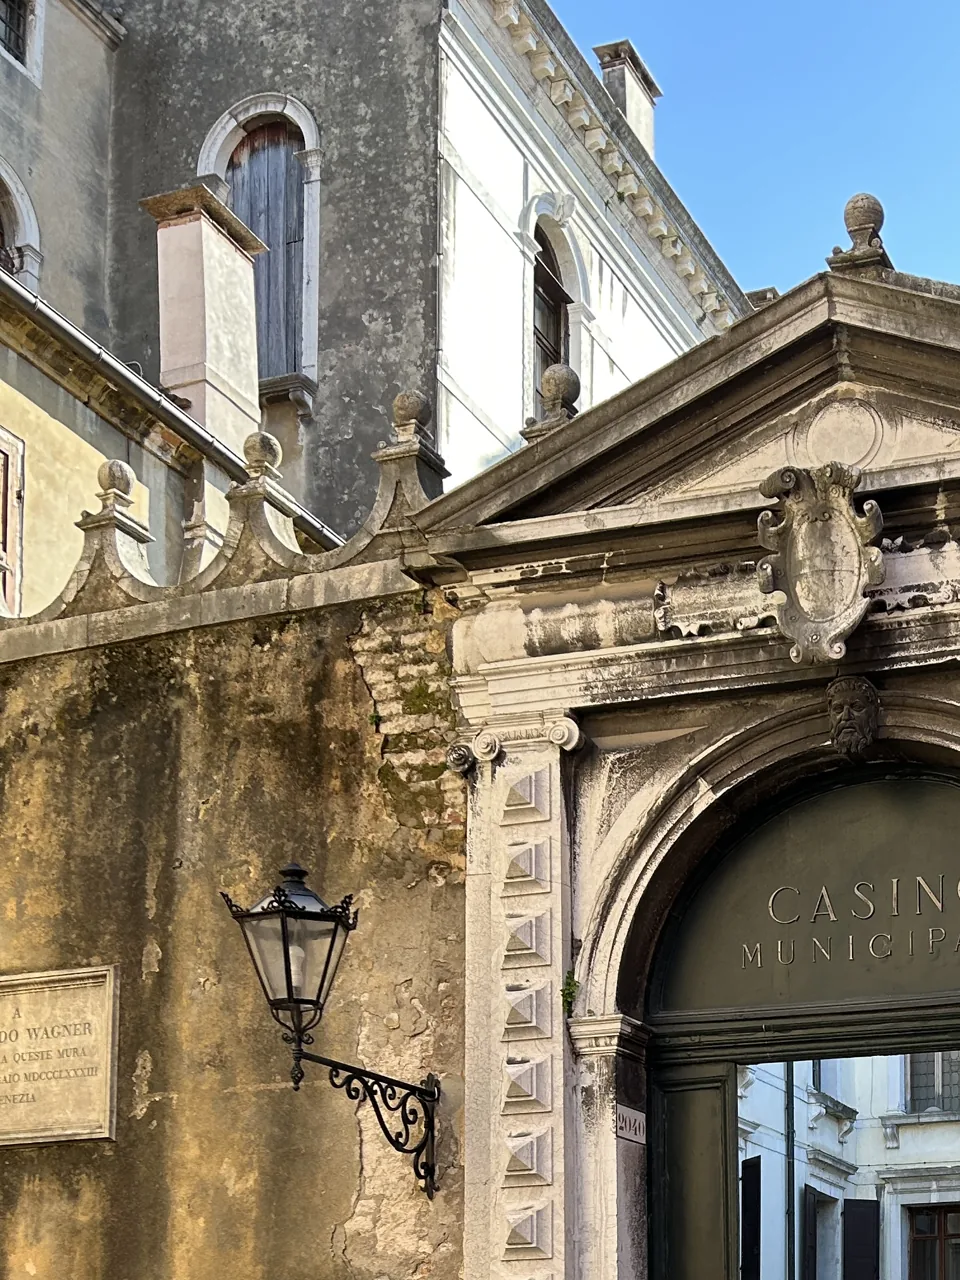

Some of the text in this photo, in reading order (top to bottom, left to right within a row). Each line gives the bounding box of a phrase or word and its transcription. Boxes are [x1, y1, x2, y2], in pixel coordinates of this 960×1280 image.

[12, 1008, 22, 1019] A
[26, 1022, 92, 1040] WAGNER
[13, 1050, 53, 1064] QUESTE
[57, 1047, 87, 1059] MURA
[24, 1067, 98, 1082] MDCCCLXXXIII
[618, 1113, 645, 1137] 2040
